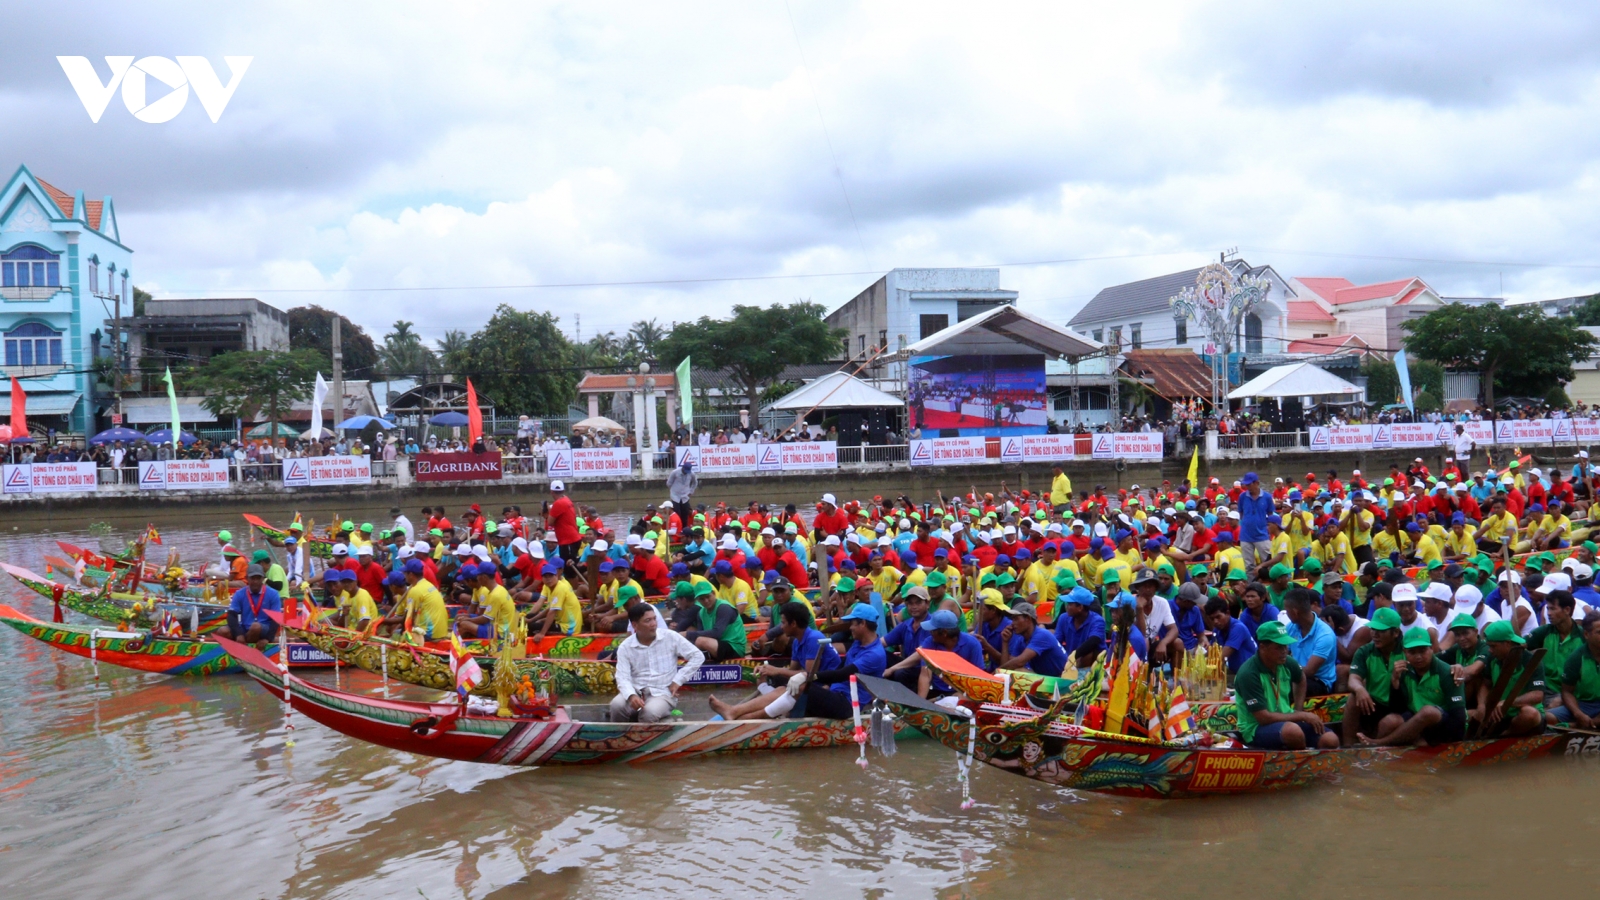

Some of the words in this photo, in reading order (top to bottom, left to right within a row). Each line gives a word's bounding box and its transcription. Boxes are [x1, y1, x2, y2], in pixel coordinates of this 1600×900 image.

[723, 456, 731, 465] 620
[803, 454, 811, 462] 620
[432, 462, 498, 472] AGRIBANK
[596, 460, 604, 469] 620
[191, 472, 199, 482] 620
[333, 468, 342, 478] 620
[57, 475, 66, 485] 620
[309, 650, 334, 660] NGAN
[722, 670, 738, 680] LONG
[1204, 754, 1255, 769] PHƯỜNG
[1194, 770, 1220, 787] TRÀ
[1222, 774, 1255, 787] VINH
